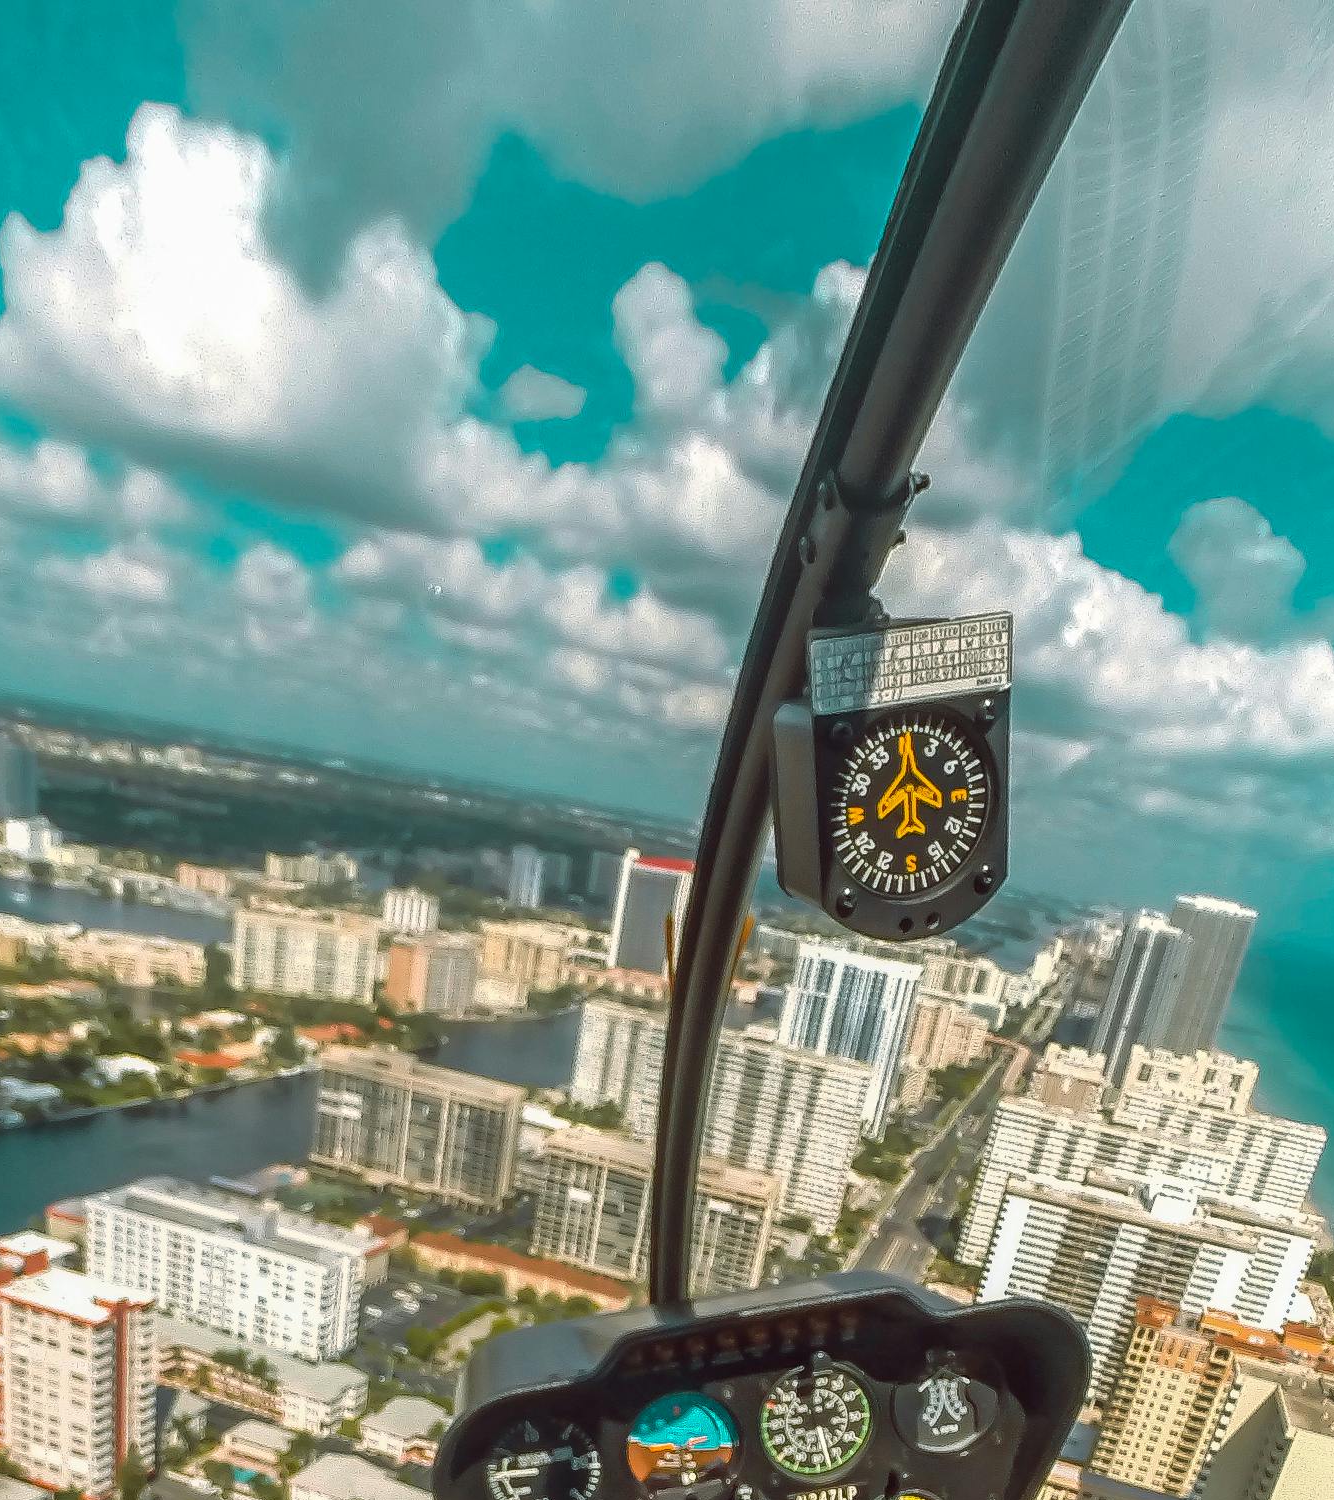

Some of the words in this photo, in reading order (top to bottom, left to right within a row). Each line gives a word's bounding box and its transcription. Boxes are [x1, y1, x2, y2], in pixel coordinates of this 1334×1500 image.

[868, 745, 890, 771] 33
[924, 738, 939, 758] 3
[943, 759, 959, 775] 6
[851, 773, 871, 797] 30
[950, 788, 967, 803] E
[847, 806, 865, 826] W
[944, 816, 963, 835] 12
[854, 831, 876, 855] 24
[927, 840, 945, 861] 15
[876, 850, 894, 870] 21
[905, 854, 917, 873] S
